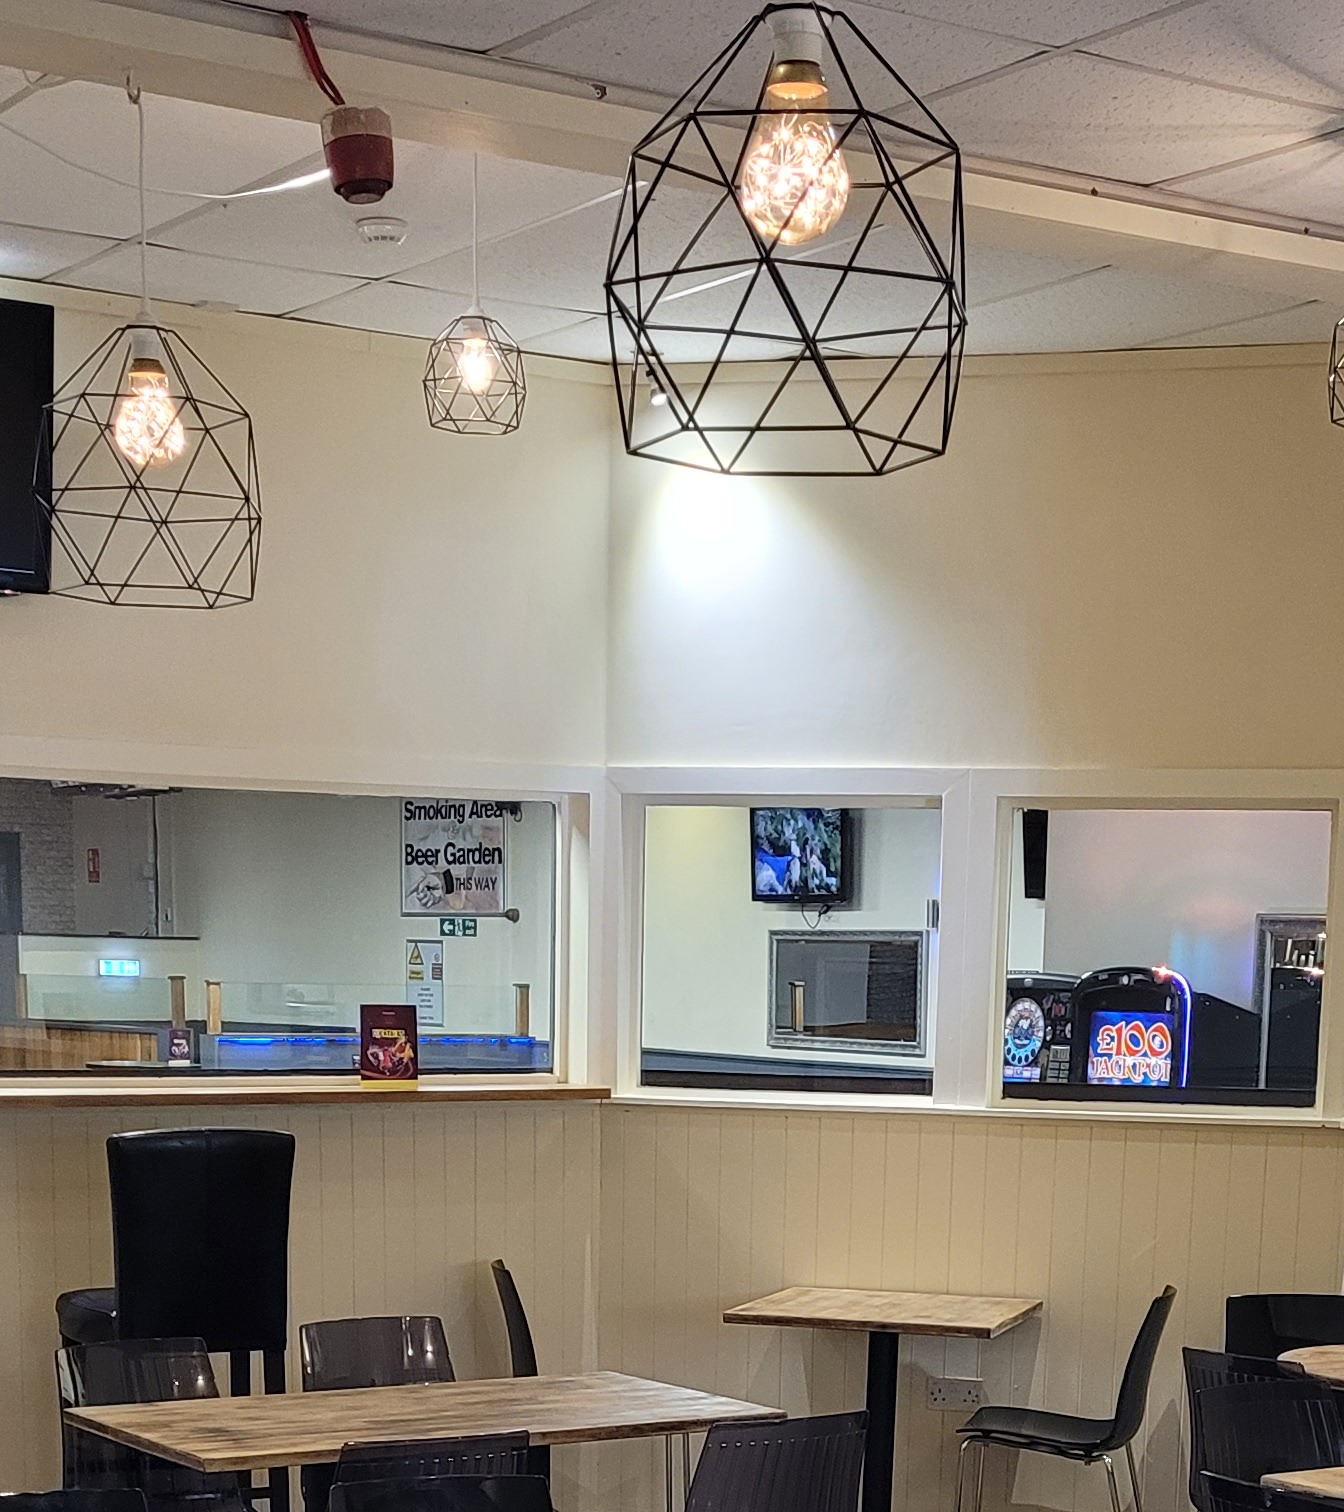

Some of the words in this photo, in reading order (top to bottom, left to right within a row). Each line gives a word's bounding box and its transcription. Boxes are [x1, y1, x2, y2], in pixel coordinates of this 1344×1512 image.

[404, 800, 466, 824] Smoking
[468, 800, 503, 819] Area
[405, 844, 441, 865] Beer
[444, 842, 503, 865] Garden
[455, 877, 472, 891] THIS
[474, 877, 498, 891] WAY
[1097, 1021, 1172, 1059] £100
[1090, 1056, 1172, 1083] JACKPOT
